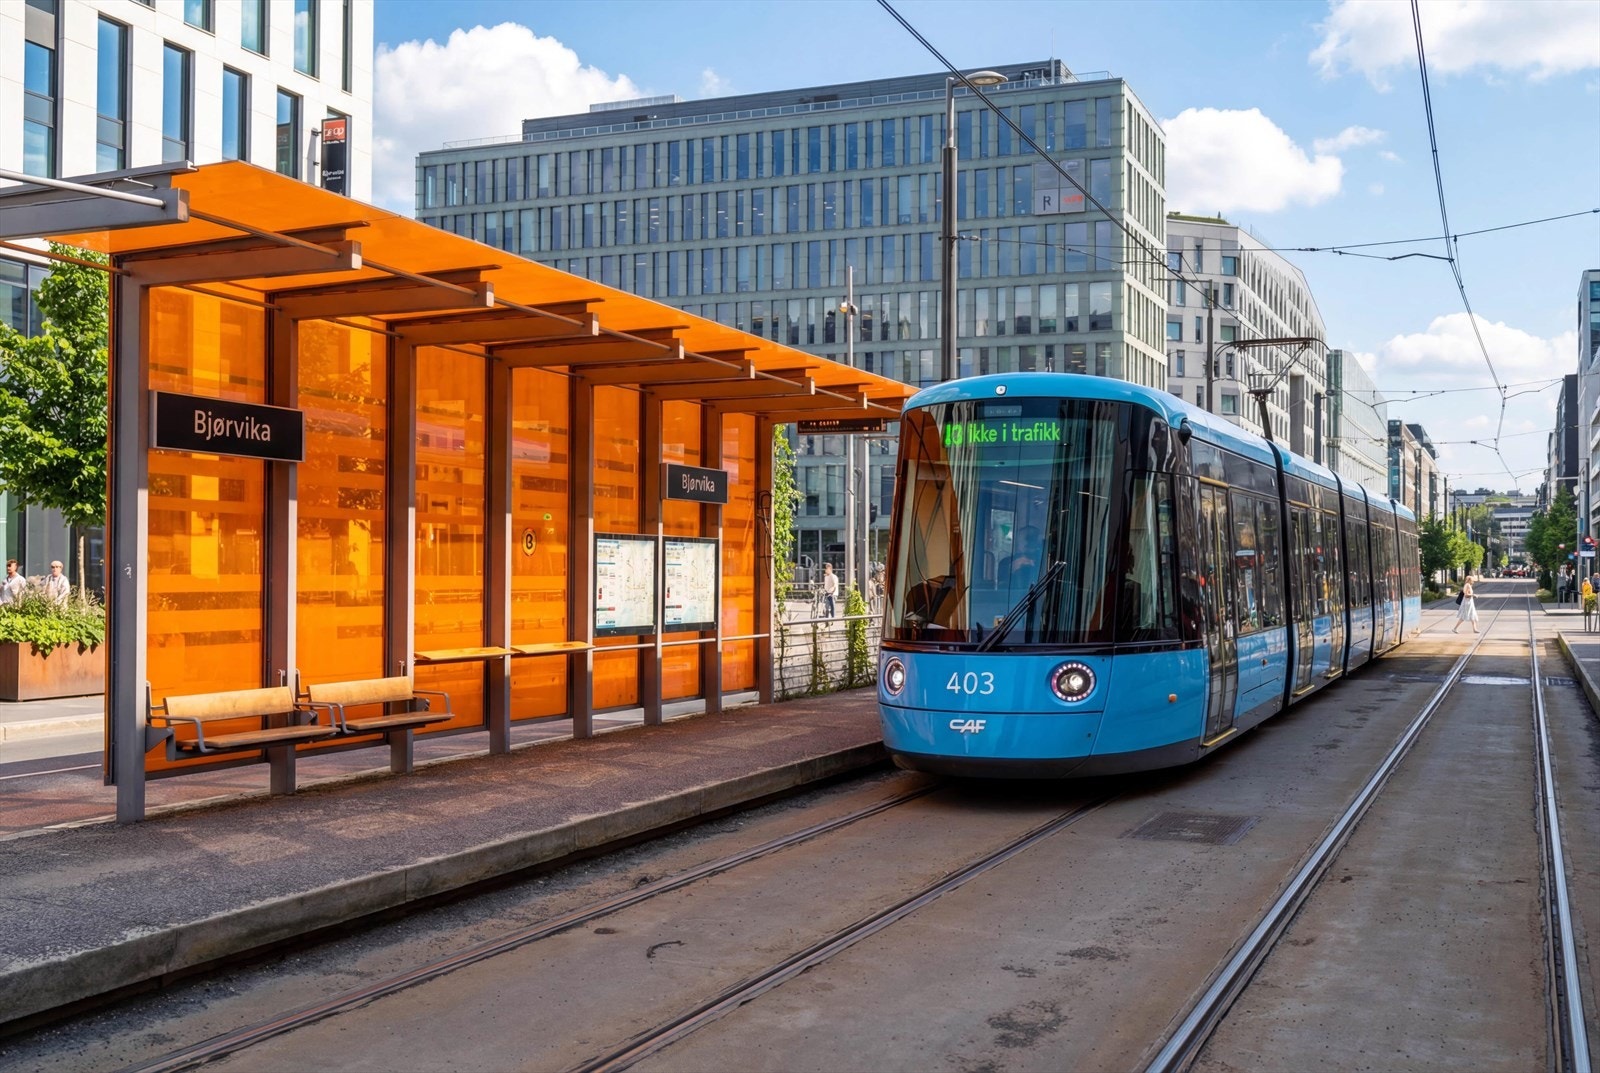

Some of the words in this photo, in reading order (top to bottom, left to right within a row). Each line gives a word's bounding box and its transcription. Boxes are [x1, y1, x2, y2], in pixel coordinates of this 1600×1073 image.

[194, 409, 271, 441] Bjørvika
[1002, 423, 1007, 442] i
[1011, 421, 1060, 442] trafikk
[681, 473, 715, 493] Bjørvika
[946, 671, 995, 695] 403
[949, 719, 987, 734] CAF
